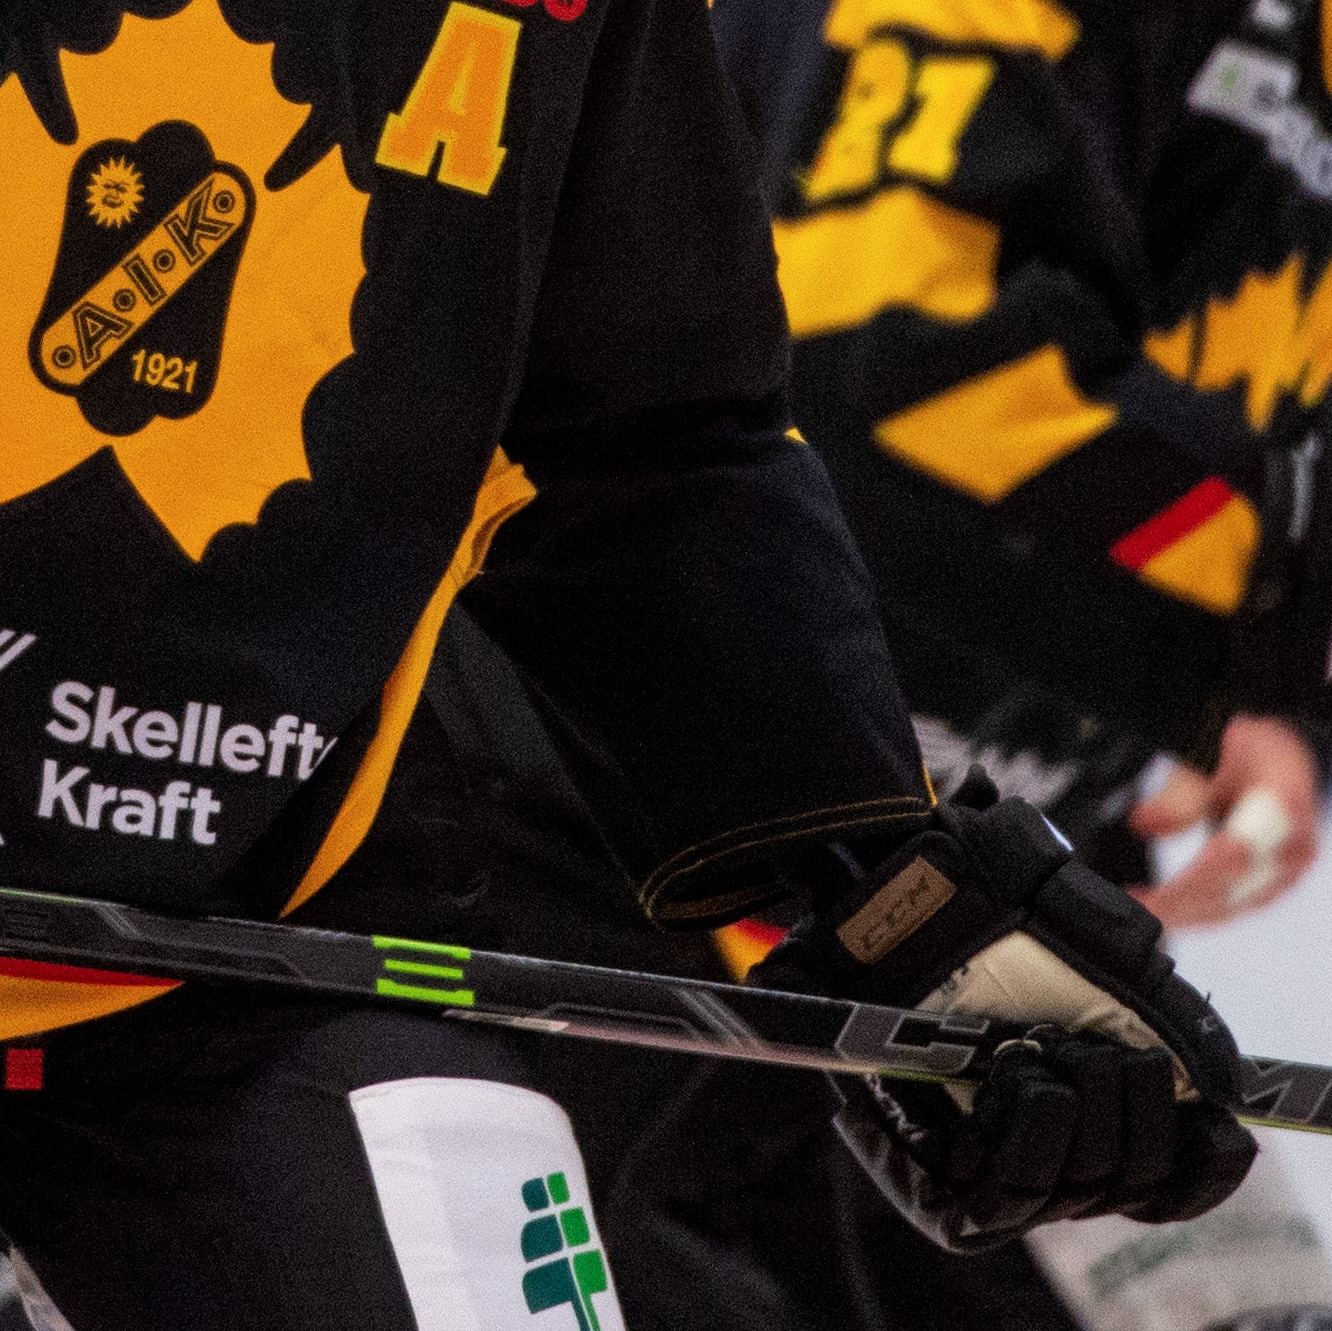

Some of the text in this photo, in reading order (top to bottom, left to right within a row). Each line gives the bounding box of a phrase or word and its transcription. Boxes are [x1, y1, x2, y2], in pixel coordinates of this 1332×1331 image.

[374, 0, 523, 196] A
[131, 348, 199, 394] 1921
[44, 679, 339, 781] Skelleft
[37, 758, 222, 846] Kraft
